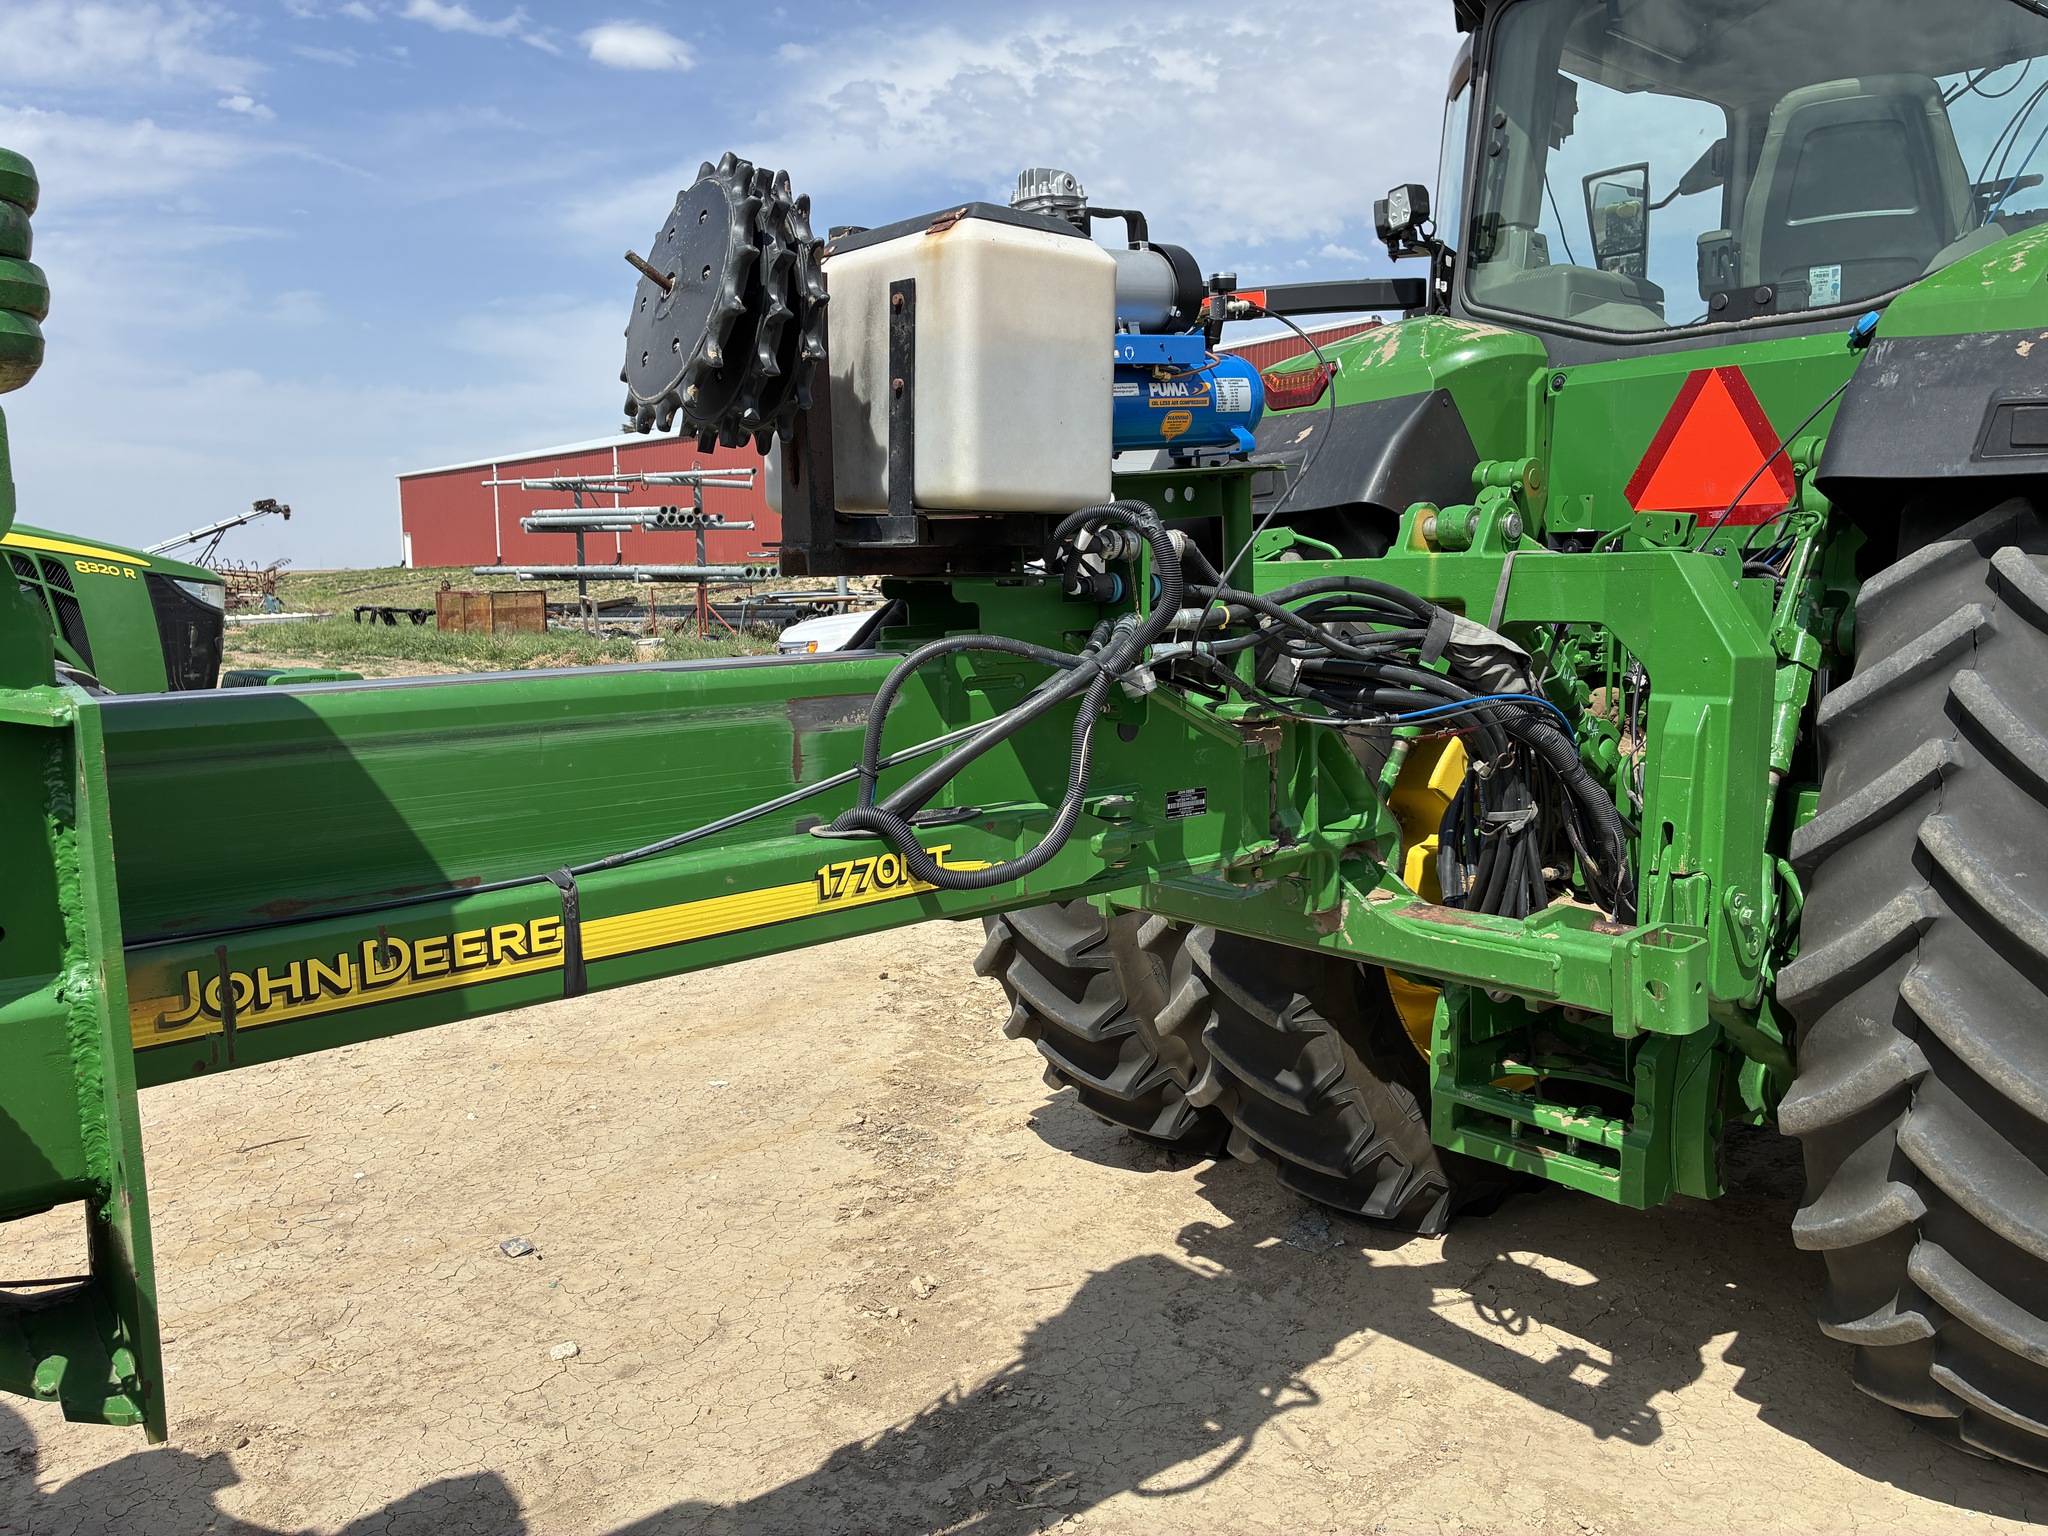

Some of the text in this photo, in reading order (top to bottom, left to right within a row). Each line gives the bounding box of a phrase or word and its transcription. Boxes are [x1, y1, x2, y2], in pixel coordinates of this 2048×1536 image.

[1148, 382, 1189, 397] PUMA
[75, 560, 137, 579] 8320 R
[159, 914, 564, 1028] JOHN DEERE
